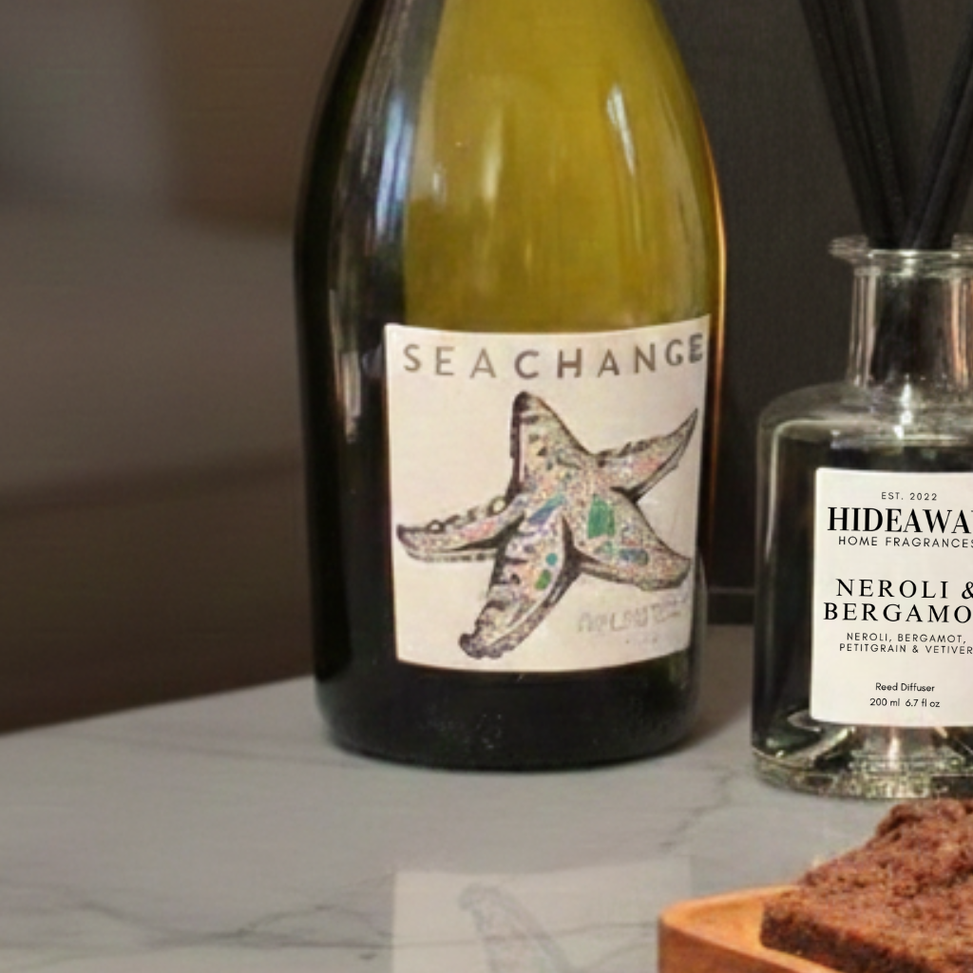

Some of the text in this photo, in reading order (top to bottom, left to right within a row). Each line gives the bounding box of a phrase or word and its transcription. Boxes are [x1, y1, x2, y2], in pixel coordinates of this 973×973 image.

[881, 491, 938, 501] EST. 2022
[838, 536, 878, 546] HOME
[836, 578, 948, 599] NEROLI
[846, 632, 967, 644] NEROLI, BERGAMOT,
[839, 643, 973, 655] PETITGRAIN & VETIVER
[875, 682, 935, 692] Reed Diffuser
[869, 697, 941, 708] 200 ml 6.7 fl oz
